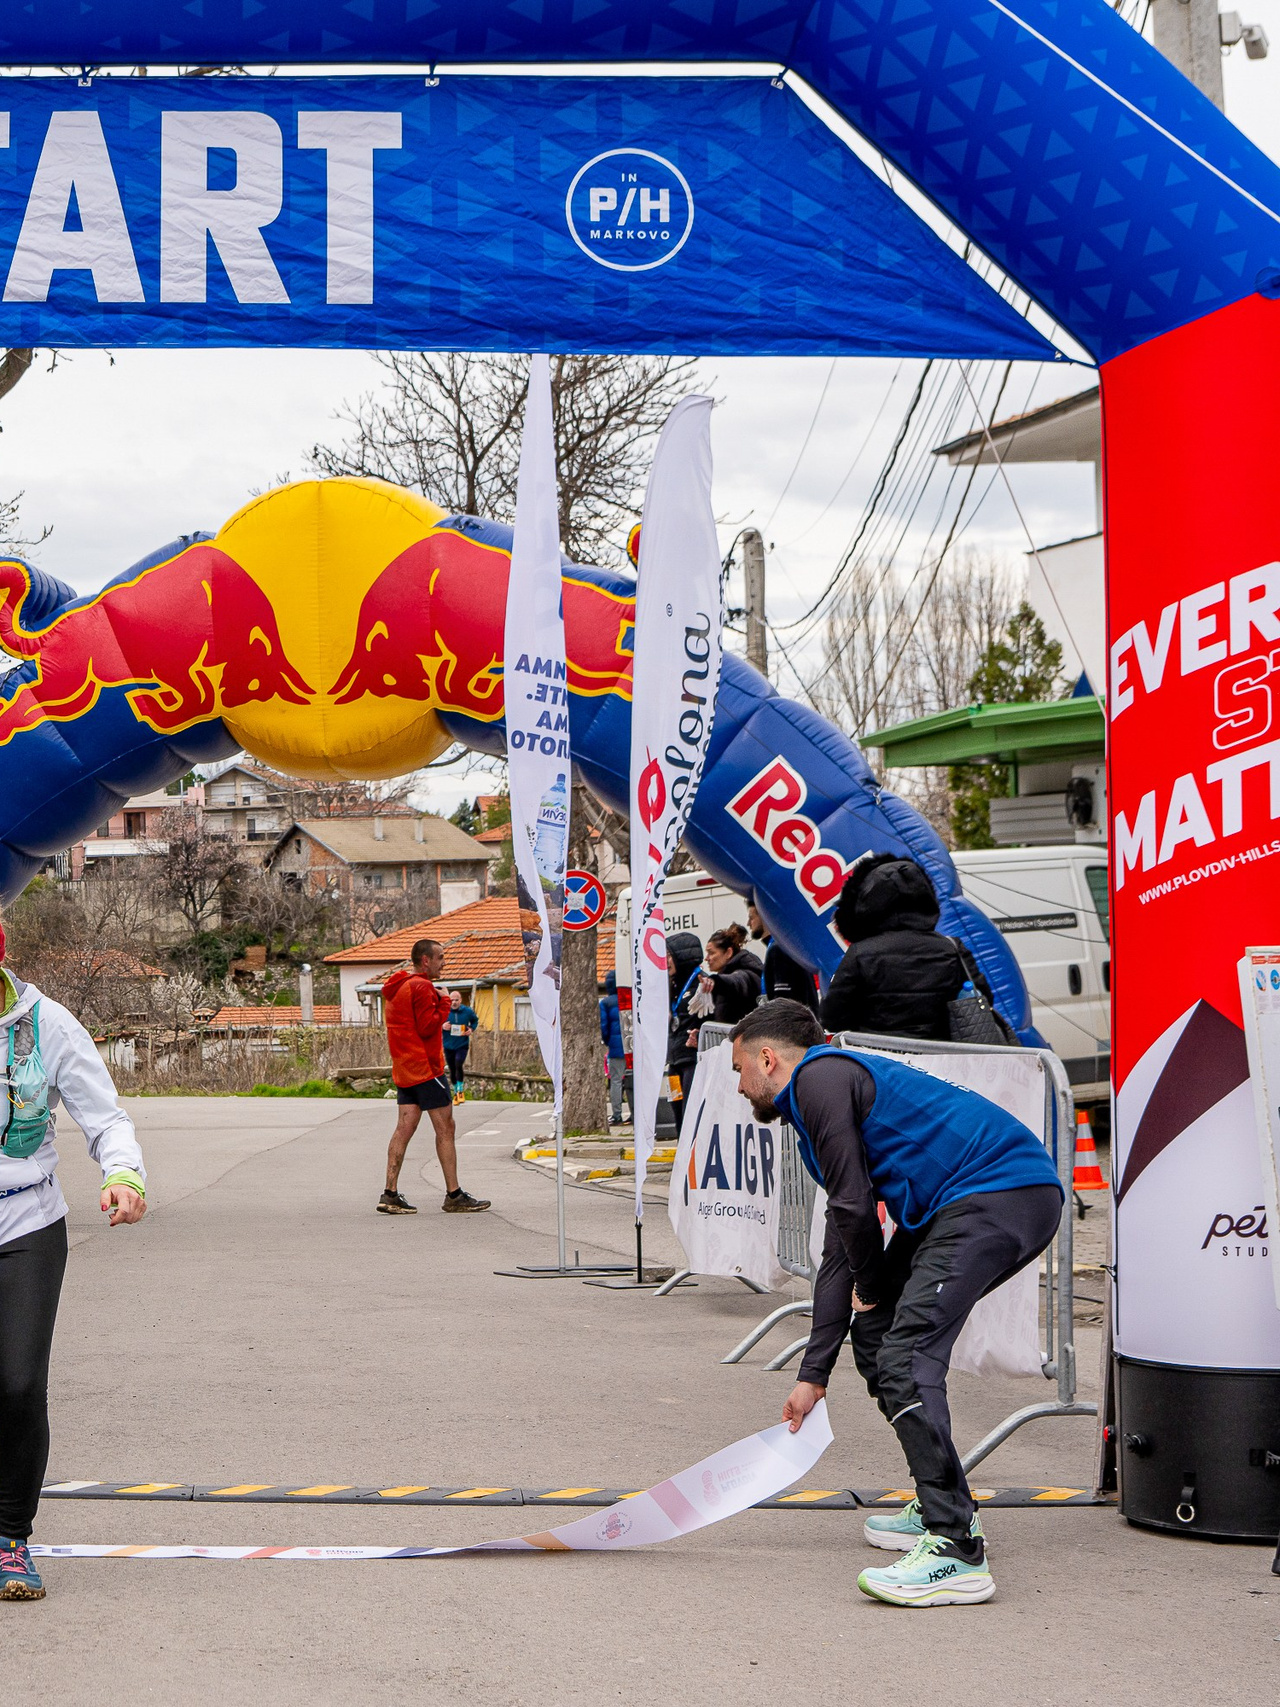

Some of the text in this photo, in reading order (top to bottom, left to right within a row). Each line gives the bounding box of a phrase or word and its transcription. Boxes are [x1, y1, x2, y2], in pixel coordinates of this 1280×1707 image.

[621, 172, 637, 182] IN
[589, 187, 670, 226] P/H
[590, 230, 670, 239] MARKOVO
[1213, 648, 1280, 750] S
[1222, 1246, 1268, 1257] STUD
[929, 1564, 958, 1583] HOKA
